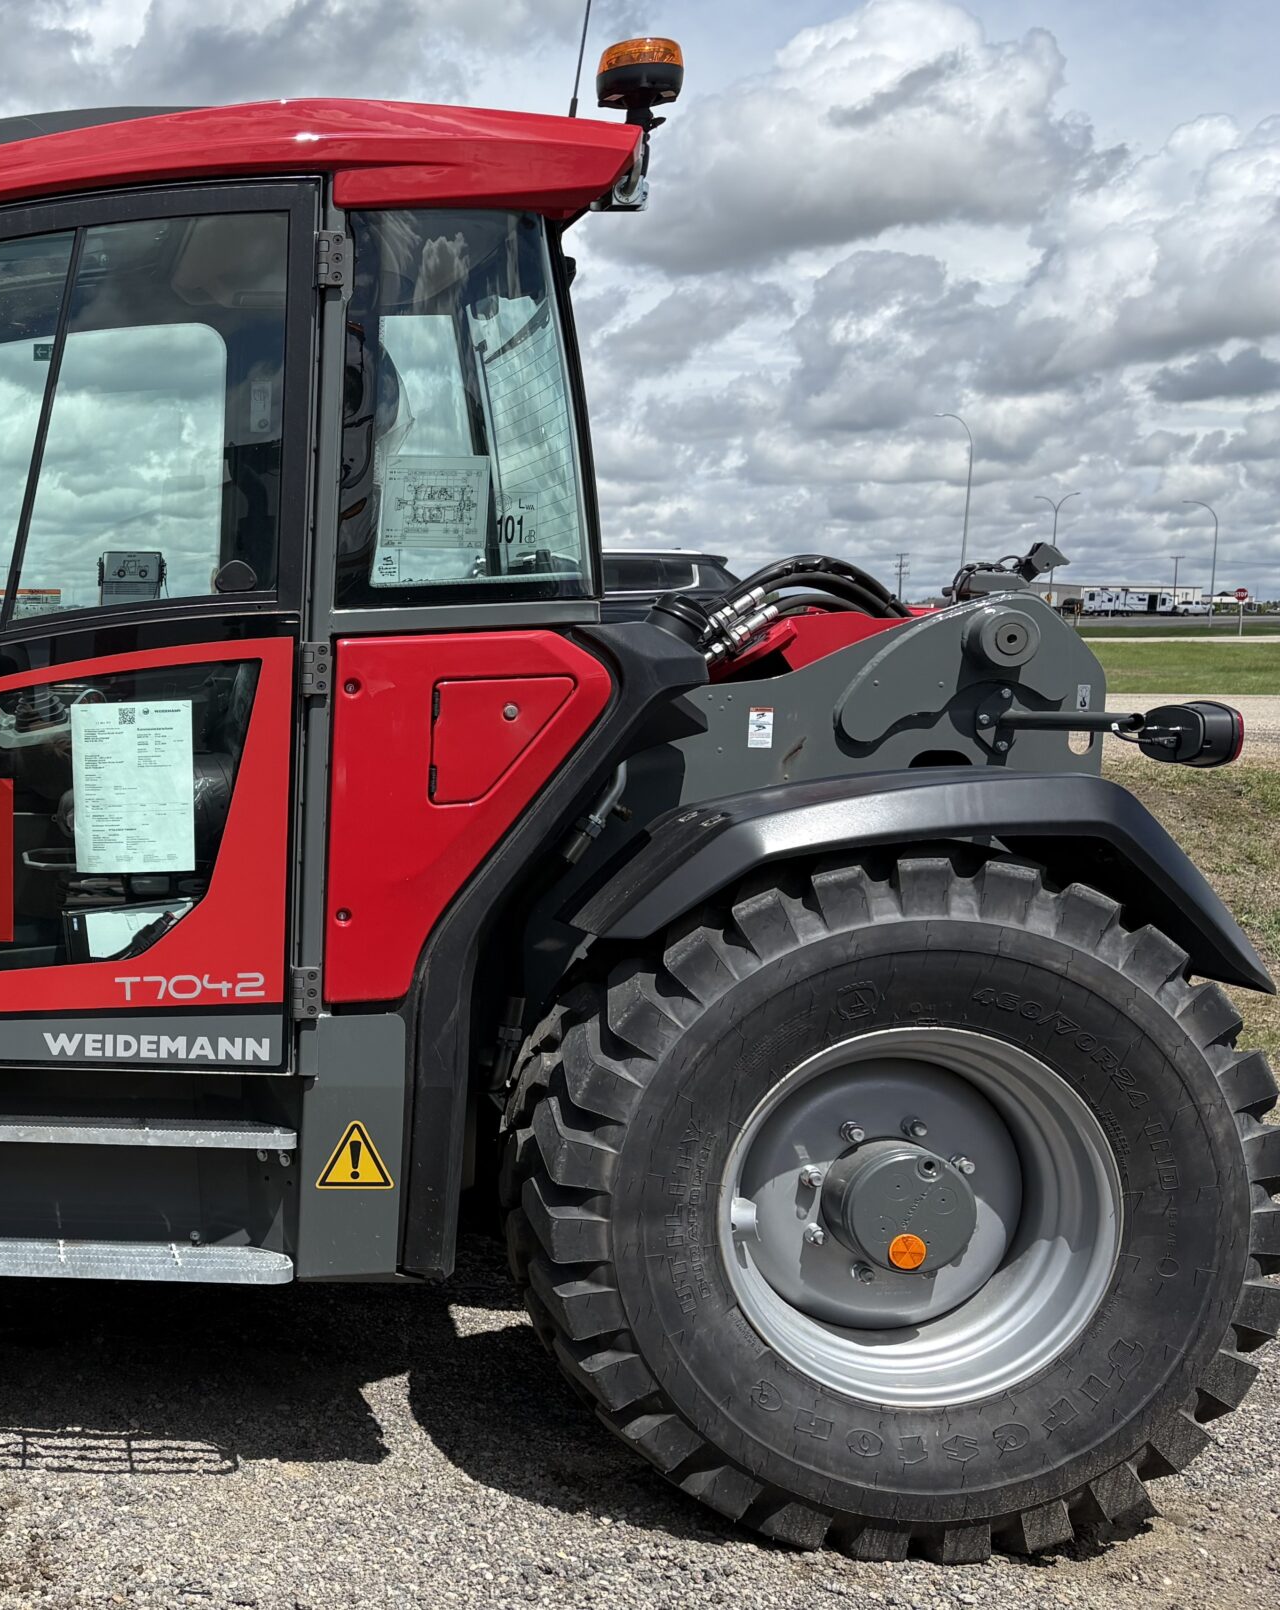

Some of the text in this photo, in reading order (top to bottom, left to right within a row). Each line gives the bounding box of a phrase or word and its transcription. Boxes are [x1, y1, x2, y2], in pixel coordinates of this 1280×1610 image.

[496, 515, 524, 544] 101
[114, 972, 266, 1001] T7042
[43, 1032, 270, 1062] WEIDEMANN
